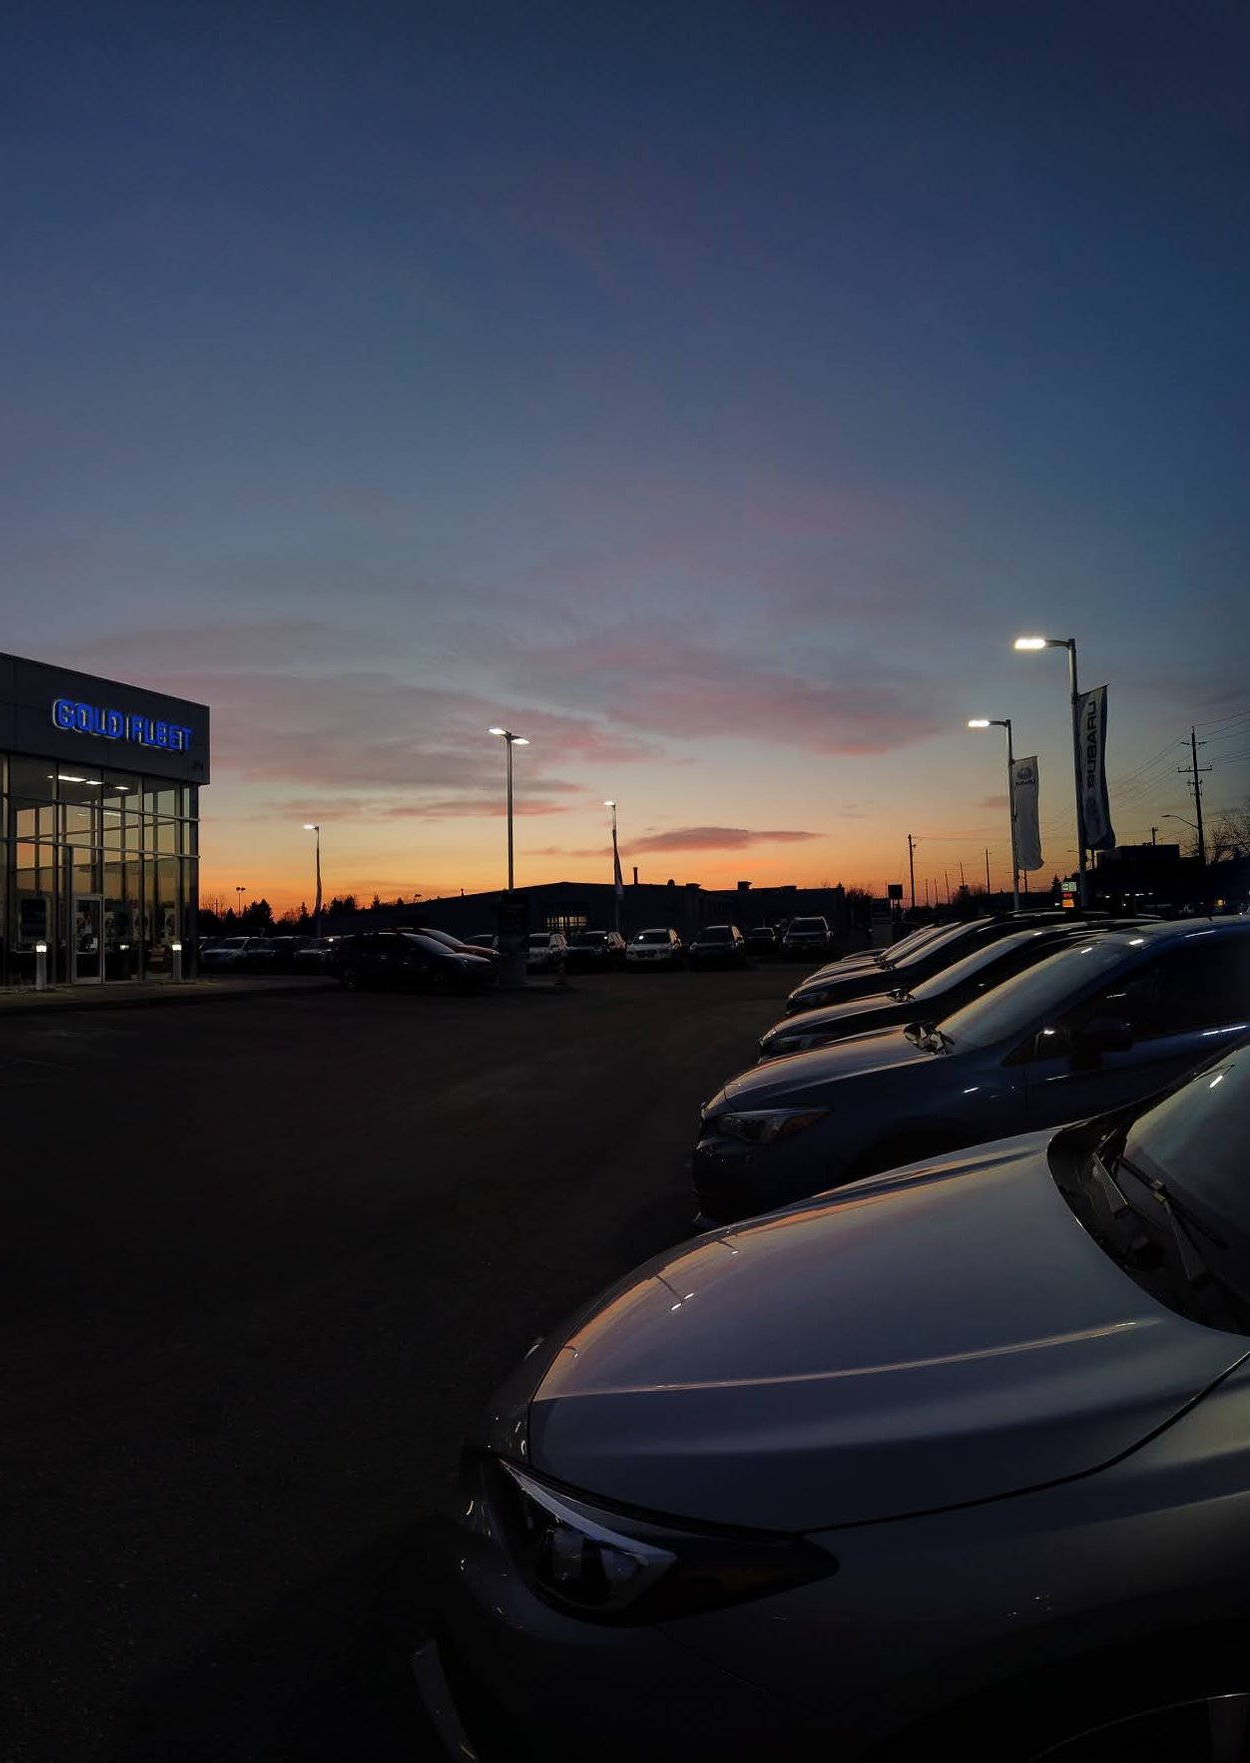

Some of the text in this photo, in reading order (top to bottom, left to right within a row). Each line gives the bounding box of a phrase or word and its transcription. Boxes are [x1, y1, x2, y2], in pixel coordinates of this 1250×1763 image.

[53, 699, 193, 752] GOLD FLEET
[1086, 701, 1097, 788] SUBARU
